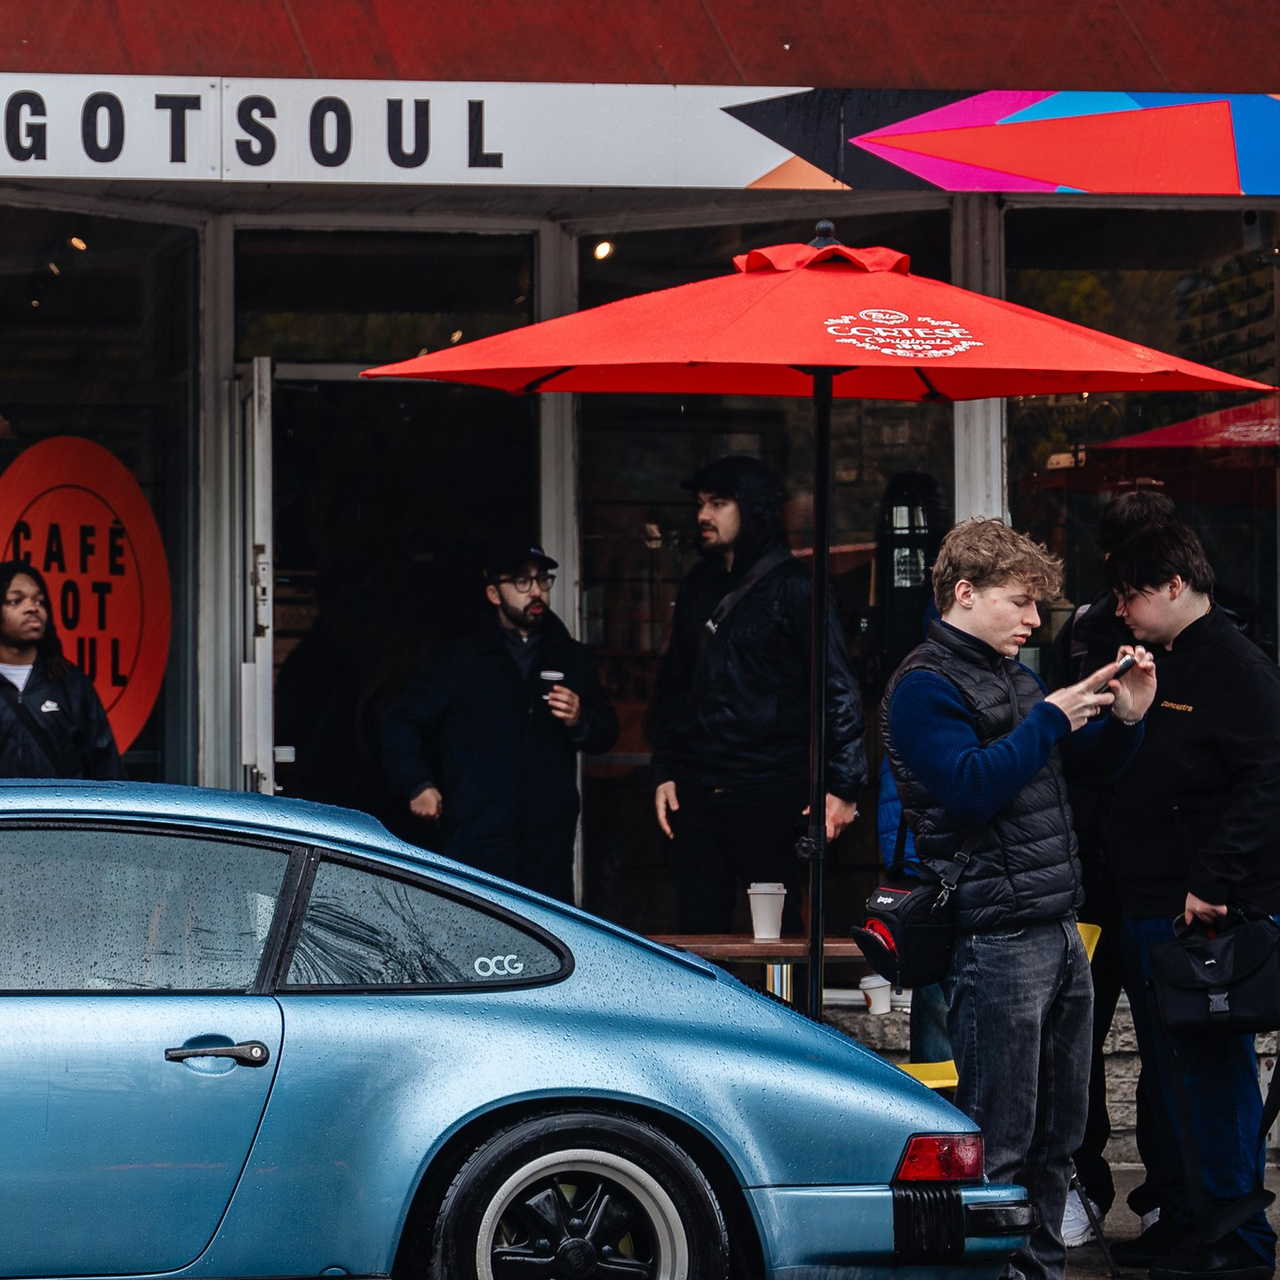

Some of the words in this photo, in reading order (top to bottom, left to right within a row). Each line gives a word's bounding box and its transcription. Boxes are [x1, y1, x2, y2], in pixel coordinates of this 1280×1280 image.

[827, 326, 973, 339] CORTESE
[864, 336, 953, 346] Originale
[61, 579, 112, 631] OT
[77, 636, 128, 687] UL
[474, 954, 524, 977] OCG
